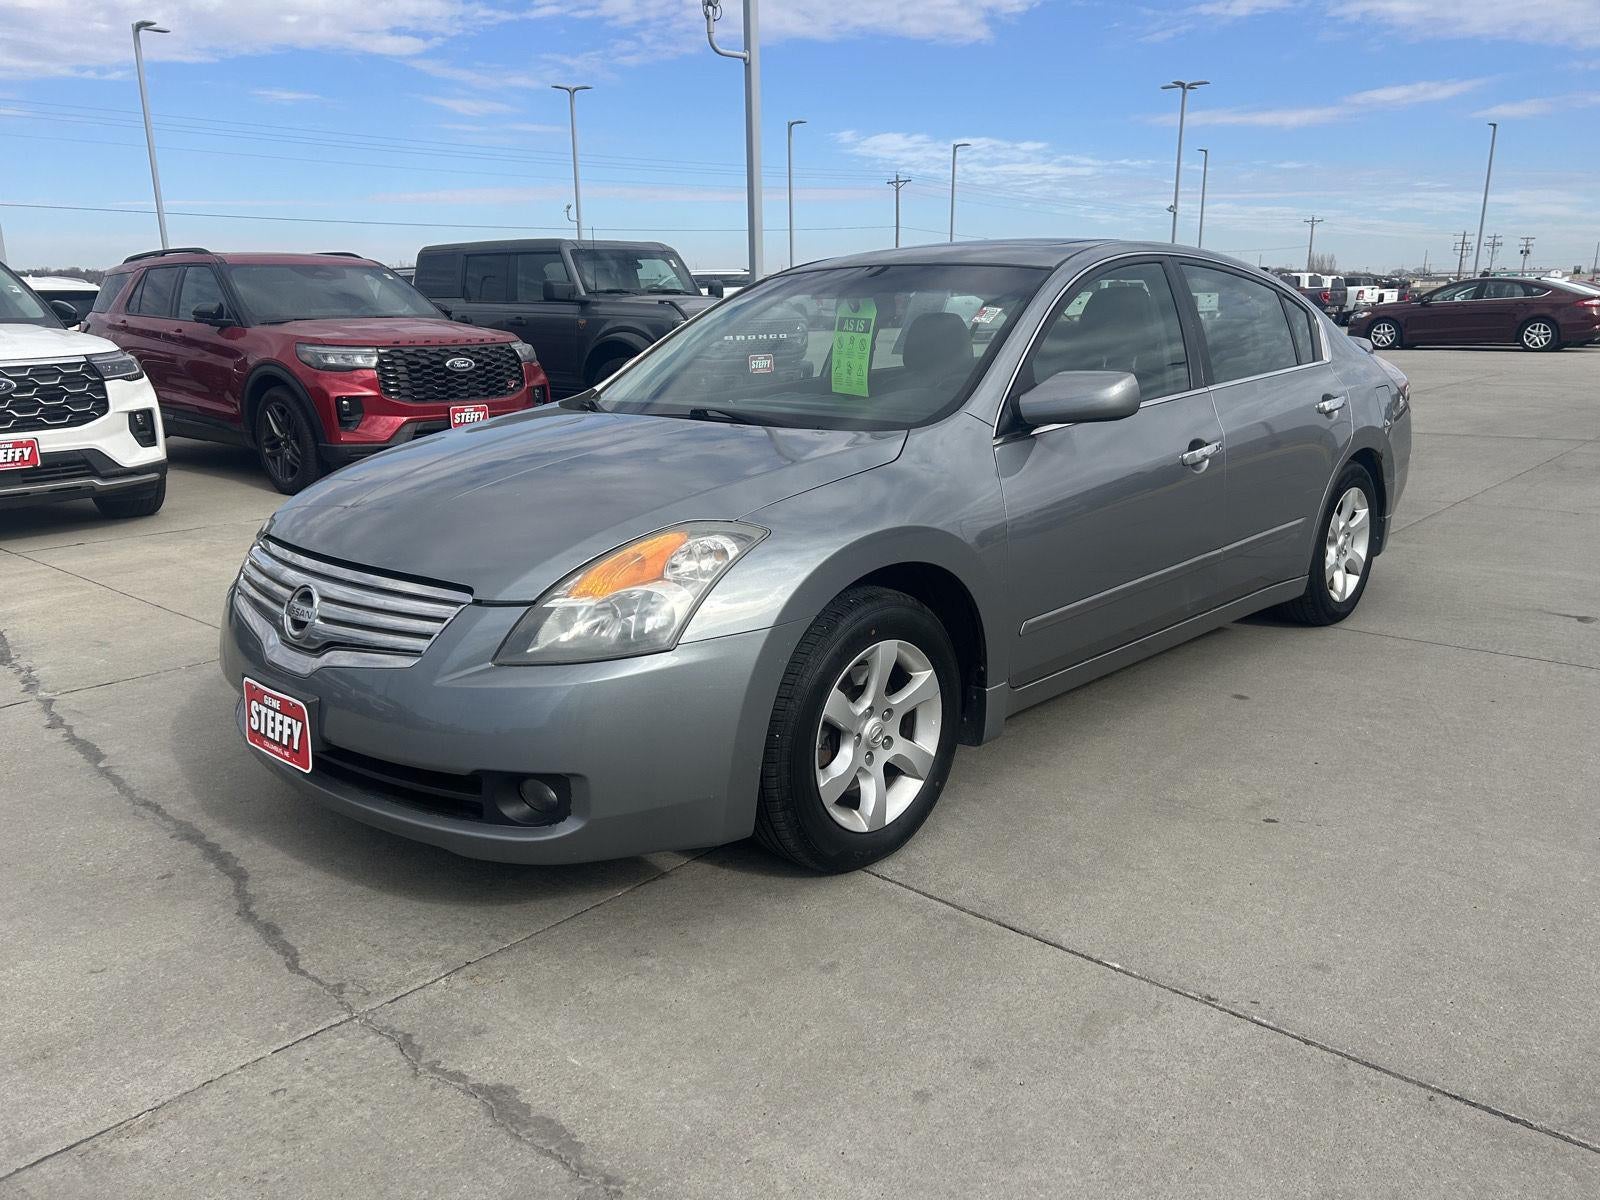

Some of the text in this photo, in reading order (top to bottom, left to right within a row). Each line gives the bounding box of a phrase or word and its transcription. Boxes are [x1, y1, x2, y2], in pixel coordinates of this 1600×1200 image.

[843, 319, 865, 332] AS IS
[724, 333, 787, 341] BRONCO
[751, 359, 771, 369] STEFFY
[454, 411, 485, 424] STEFFY
[0, 446, 32, 463] EFFY
[263, 694, 281, 711] GENE
[250, 700, 302, 751] STEFFY
[283, 750, 290, 758] NE
